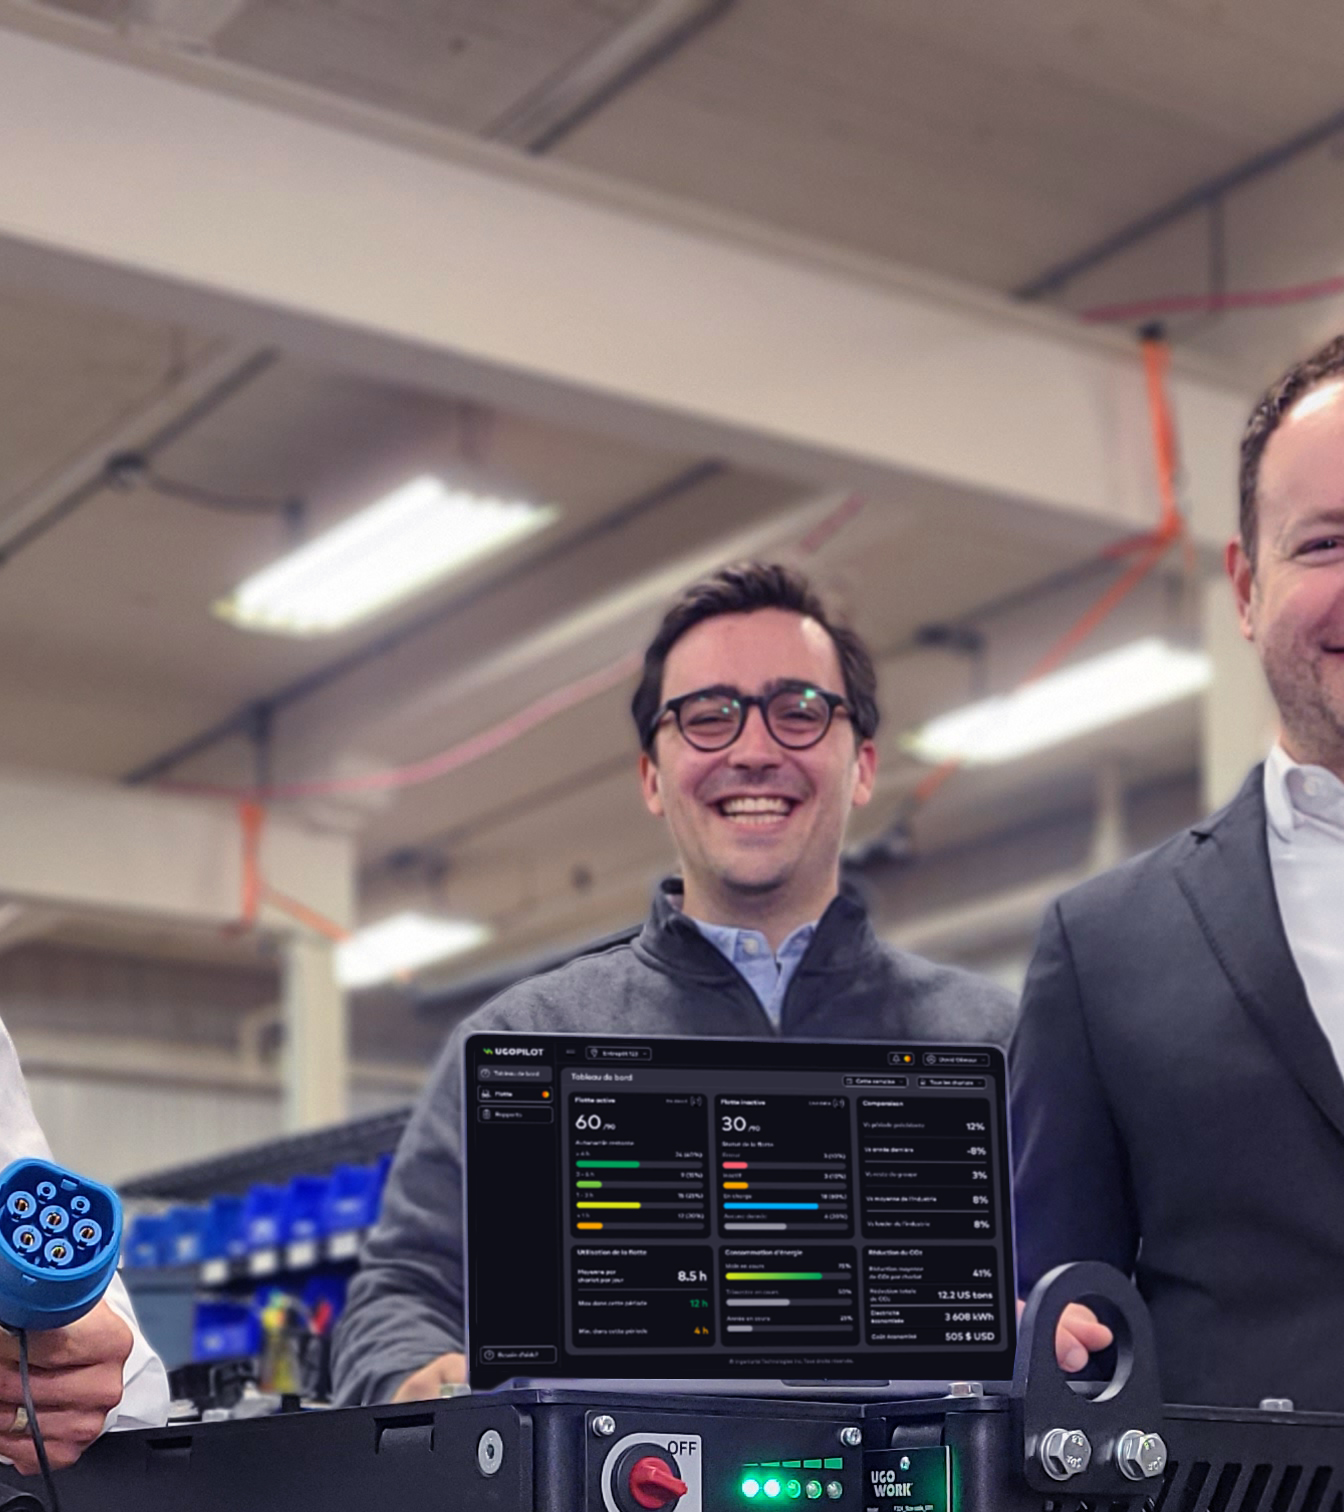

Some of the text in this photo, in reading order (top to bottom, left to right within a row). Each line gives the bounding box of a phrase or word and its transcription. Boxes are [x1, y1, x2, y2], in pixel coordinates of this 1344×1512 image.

[495, 1048, 544, 1057] UGOPILOT
[571, 1073, 633, 1082] Tableau de bord
[575, 1114, 602, 1130] 60
[721, 1116, 747, 1132] 30
[966, 1122, 986, 1131] 12%
[966, 1147, 987, 1156] -8%
[972, 1171, 988, 1180] 3%
[972, 1195, 989, 1205] 8%
[973, 1220, 990, 1229] 8%
[677, 1270, 708, 1282] 8.5 h
[972, 1269, 992, 1278] 41%
[937, 1291, 993, 1300] 12.2 US tons
[690, 1299, 709, 1308] 12 h
[944, 1312, 995, 1321] 3 608 kWh
[693, 1327, 709, 1335] 4 h
[944, 1331, 995, 1341] 505 $ USD
[667, 1441, 697, 1456] OFF
[871, 1470, 896, 1484] UGO
[873, 1483, 912, 1498] WORK
